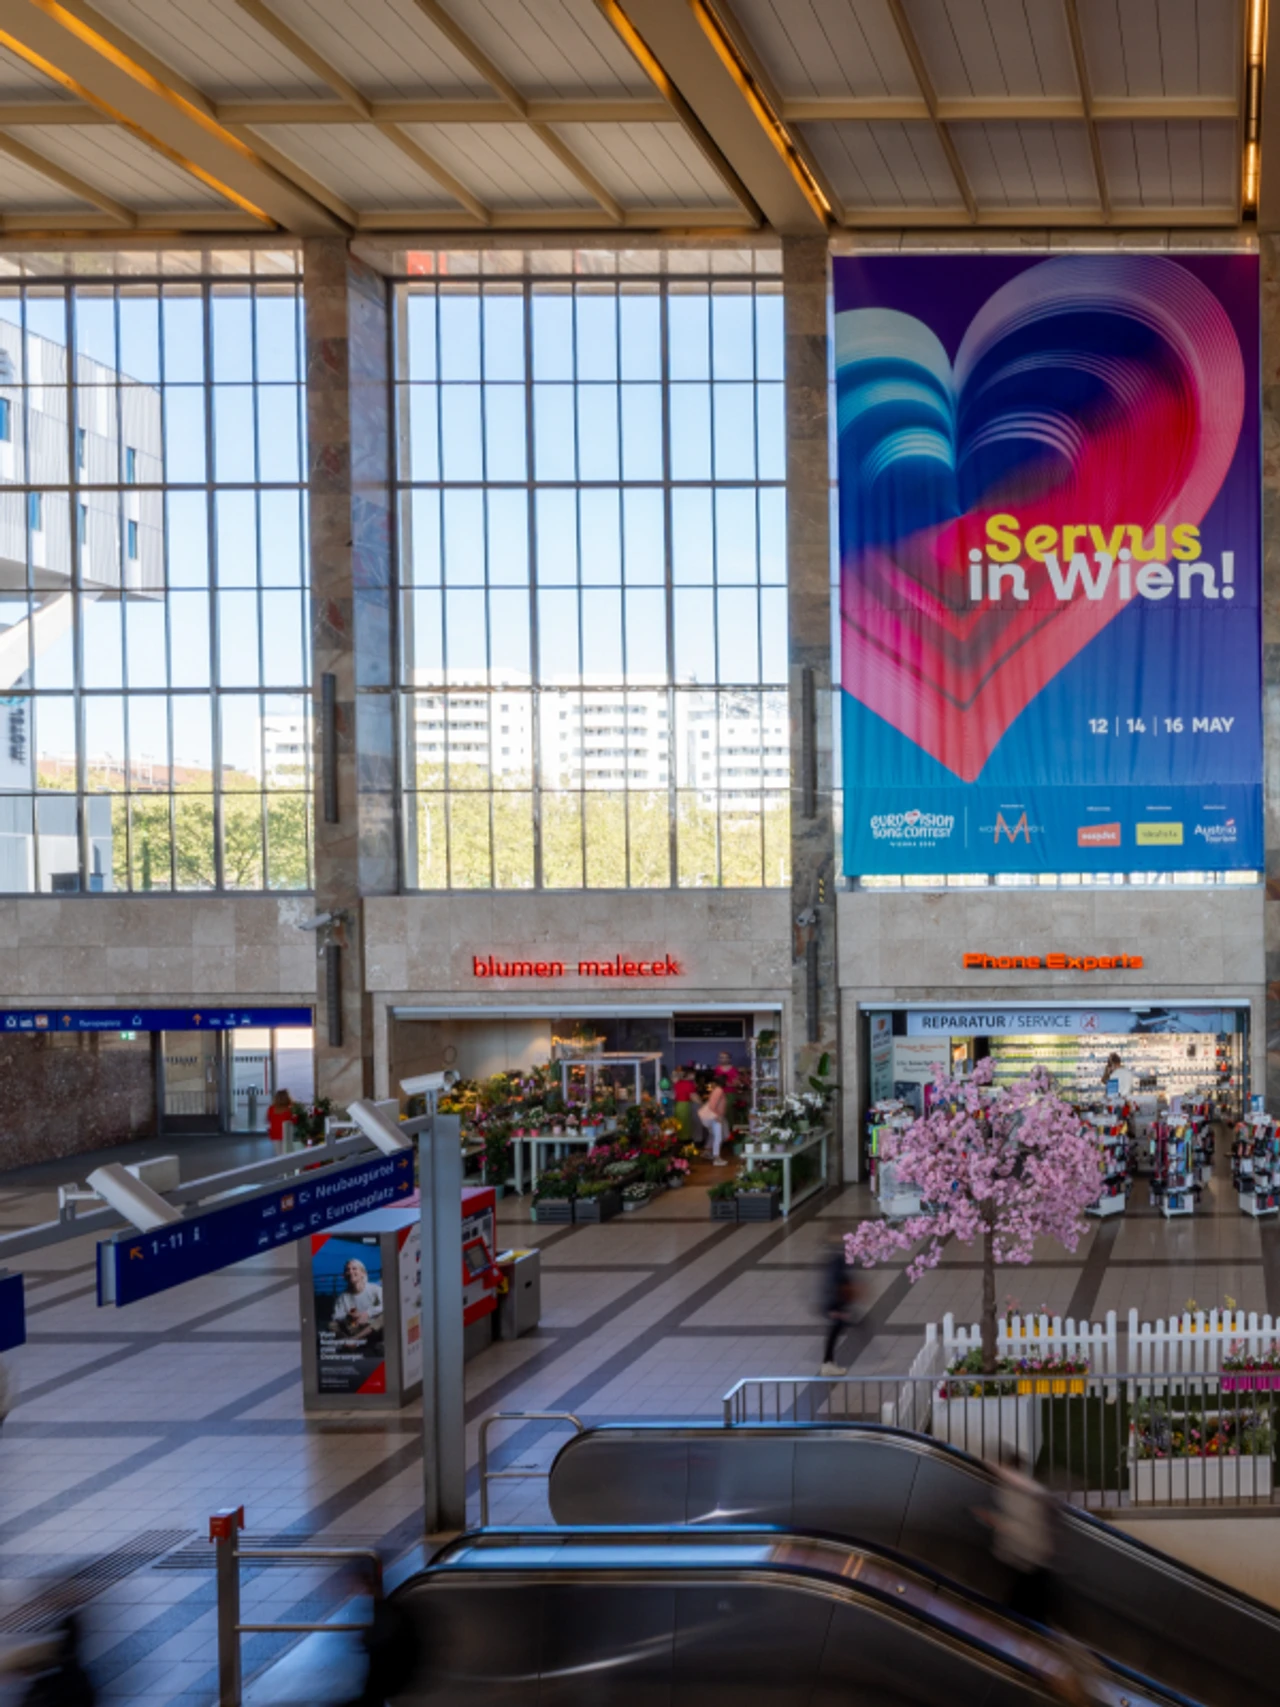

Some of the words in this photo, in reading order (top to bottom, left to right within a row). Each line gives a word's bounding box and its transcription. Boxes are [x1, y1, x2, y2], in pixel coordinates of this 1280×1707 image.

[985, 513, 1203, 563] Servus
[968, 548, 1030, 601] in
[1043, 548, 1235, 601] Wien!
[1088, 718, 1109, 735] 12
[1125, 718, 1147, 734] 14
[1164, 717, 1185, 734] 16
[1191, 717, 1235, 733] MAY
[472, 954, 565, 977] blumen
[577, 953, 681, 977] malecek
[962, 952, 1042, 970] Phone
[1045, 951, 1144, 972] Experts
[921, 1014, 1006, 1029] REPARATUR
[1016, 1014, 1072, 1028] SERVICE
[326, 1186, 395, 1220] Europaplatz
